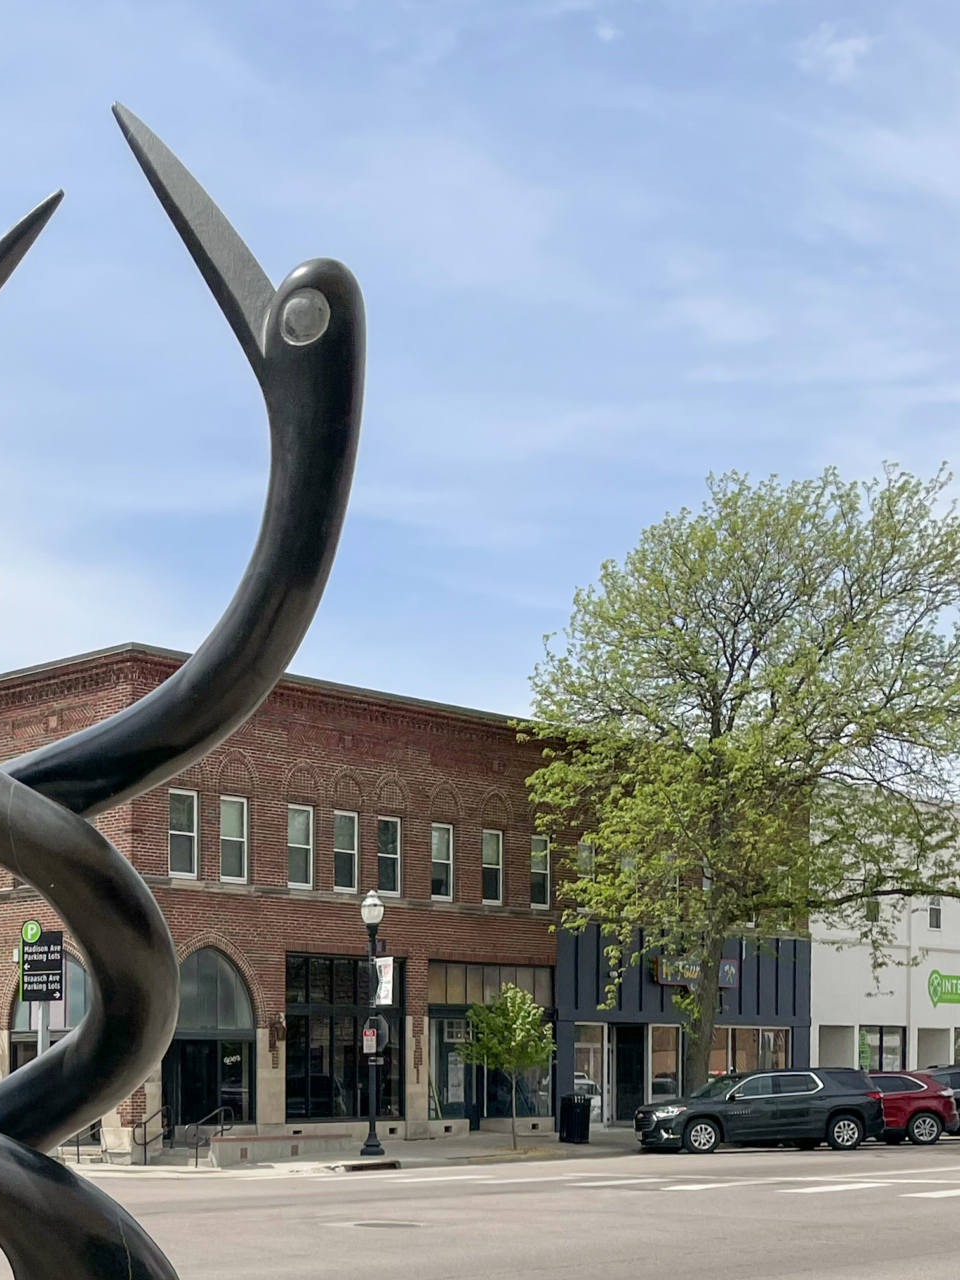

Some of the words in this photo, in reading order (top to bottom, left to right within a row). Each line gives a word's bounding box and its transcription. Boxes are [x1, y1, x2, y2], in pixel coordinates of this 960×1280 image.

[27, 924, 37, 940] P
[24, 945, 48, 953] Madison
[50, 944, 61, 952] Ave
[24, 953, 47, 962] Parking
[24, 974, 47, 982] Braasch
[49, 974, 60, 982] Ave
[24, 982, 47, 991] Parking
[48, 982, 61, 990] Lots
